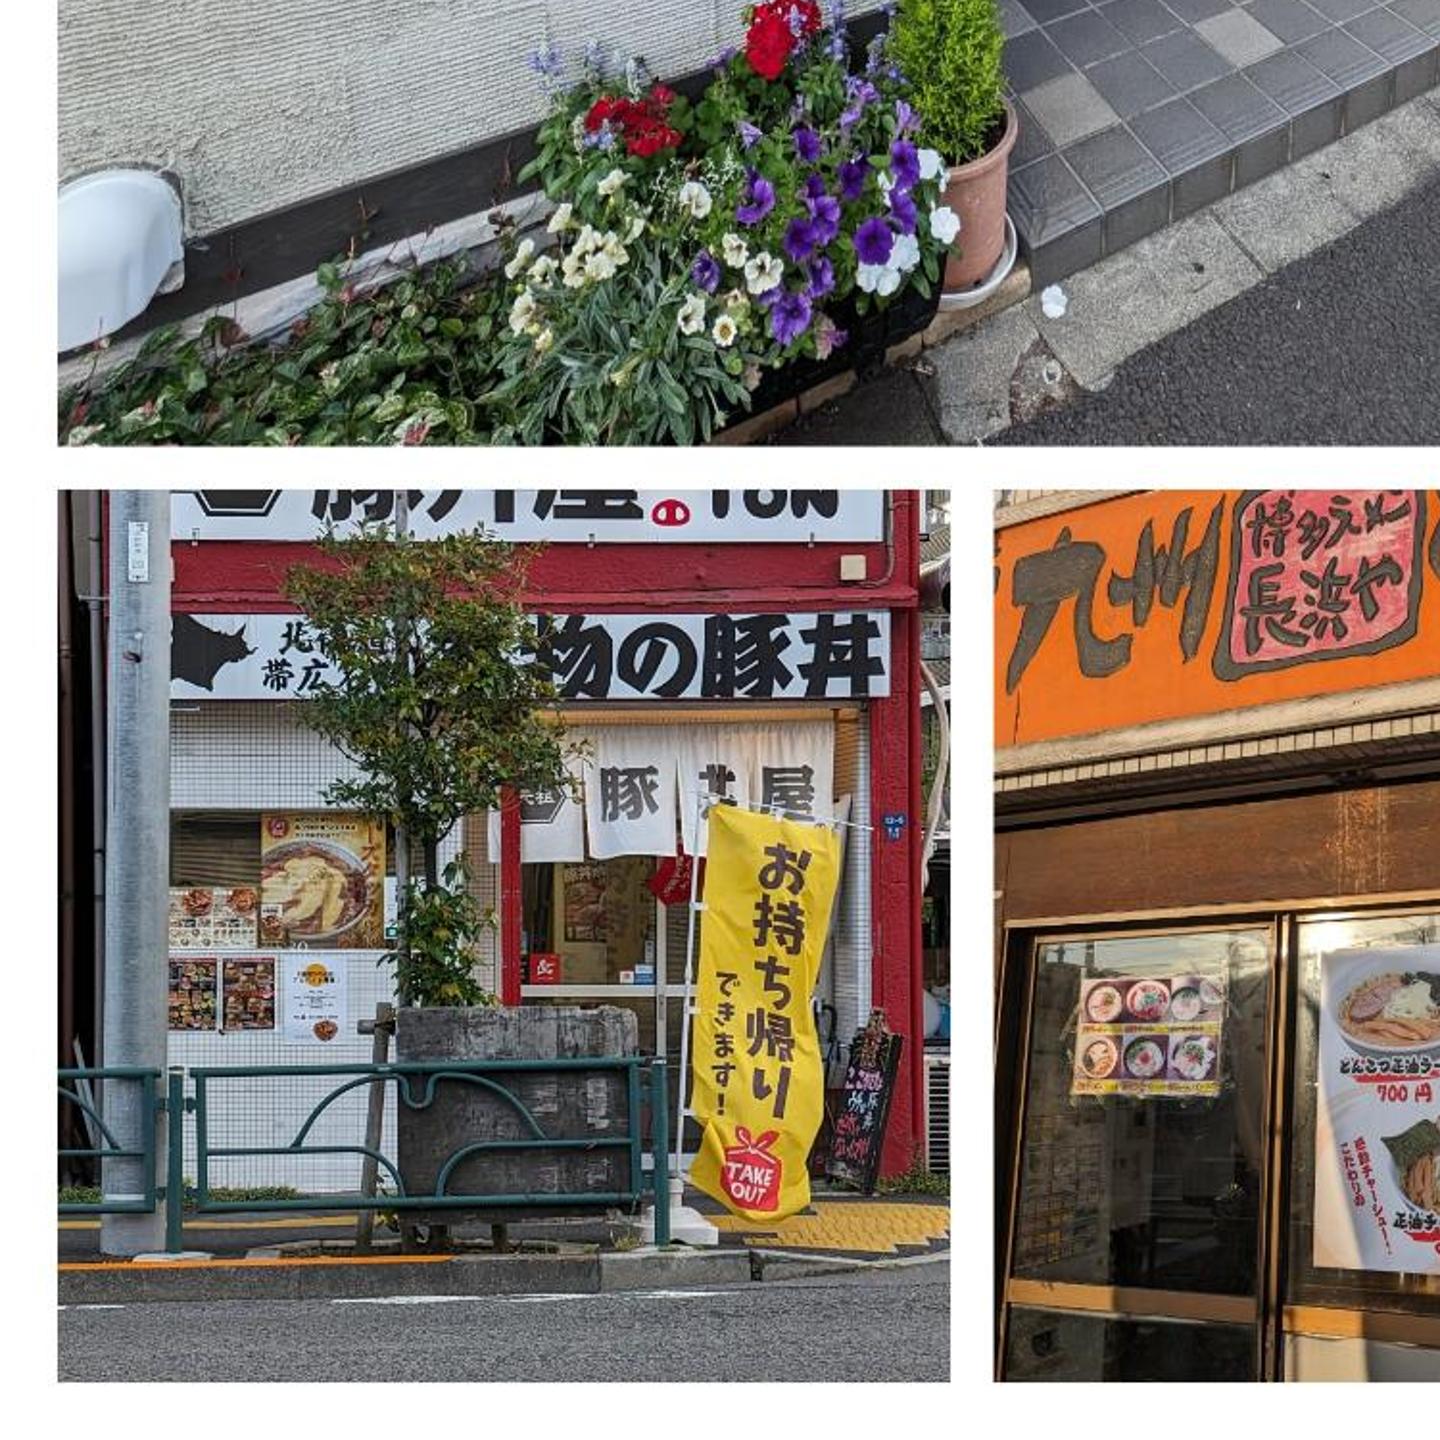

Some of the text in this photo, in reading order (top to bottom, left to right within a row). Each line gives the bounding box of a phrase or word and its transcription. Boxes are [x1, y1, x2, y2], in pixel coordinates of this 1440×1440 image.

[1006, 489, 1225, 696] 九州
[1241, 554, 1402, 656] 長浜や
[522, 614, 885, 698] 物の豚丼
[746, 843, 812, 1120] お持ち帰り
[711, 971, 740, 1115] できます！
[728, 1161, 775, 1186] TAKE
[730, 1180, 770, 1203] OUT
